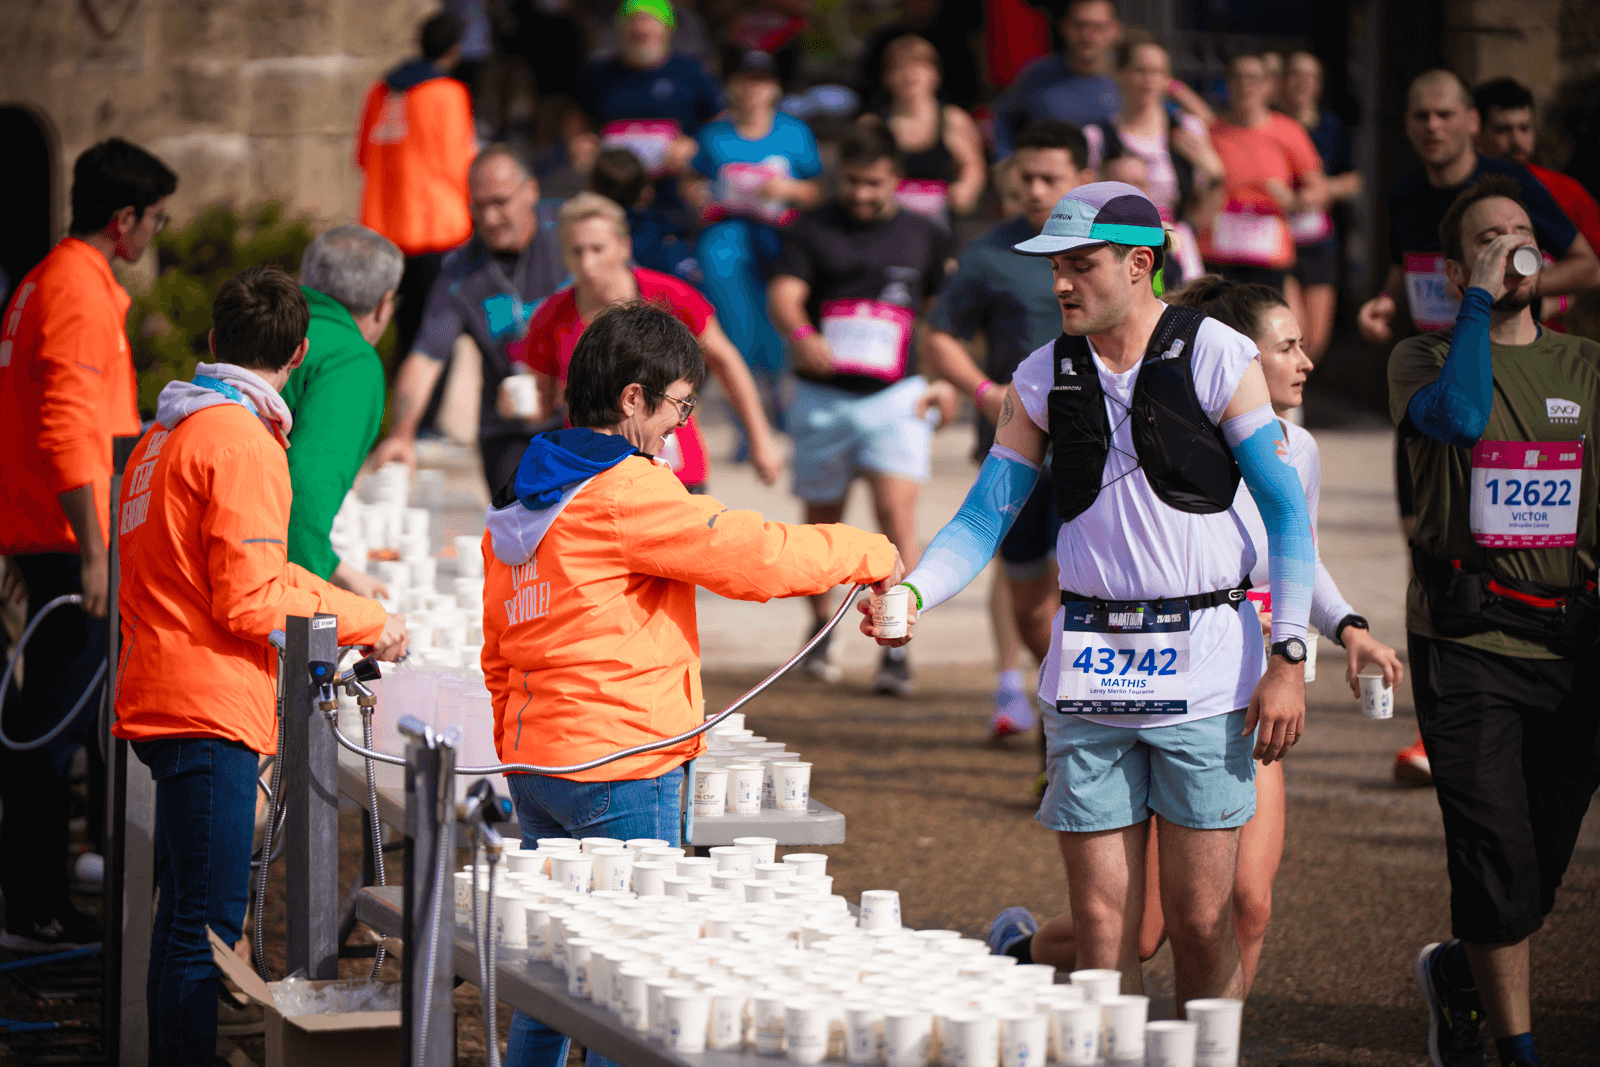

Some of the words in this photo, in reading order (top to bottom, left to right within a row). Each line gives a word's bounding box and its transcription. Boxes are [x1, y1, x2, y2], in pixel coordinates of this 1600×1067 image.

[1549, 405, 1578, 415] SNCF
[1486, 478, 1572, 506] 12622
[1512, 512, 1548, 521] VICTOR
[1108, 612, 1144, 626] MARATHON
[1072, 646, 1178, 676] 43742
[1100, 678, 1147, 688] MATHIS
